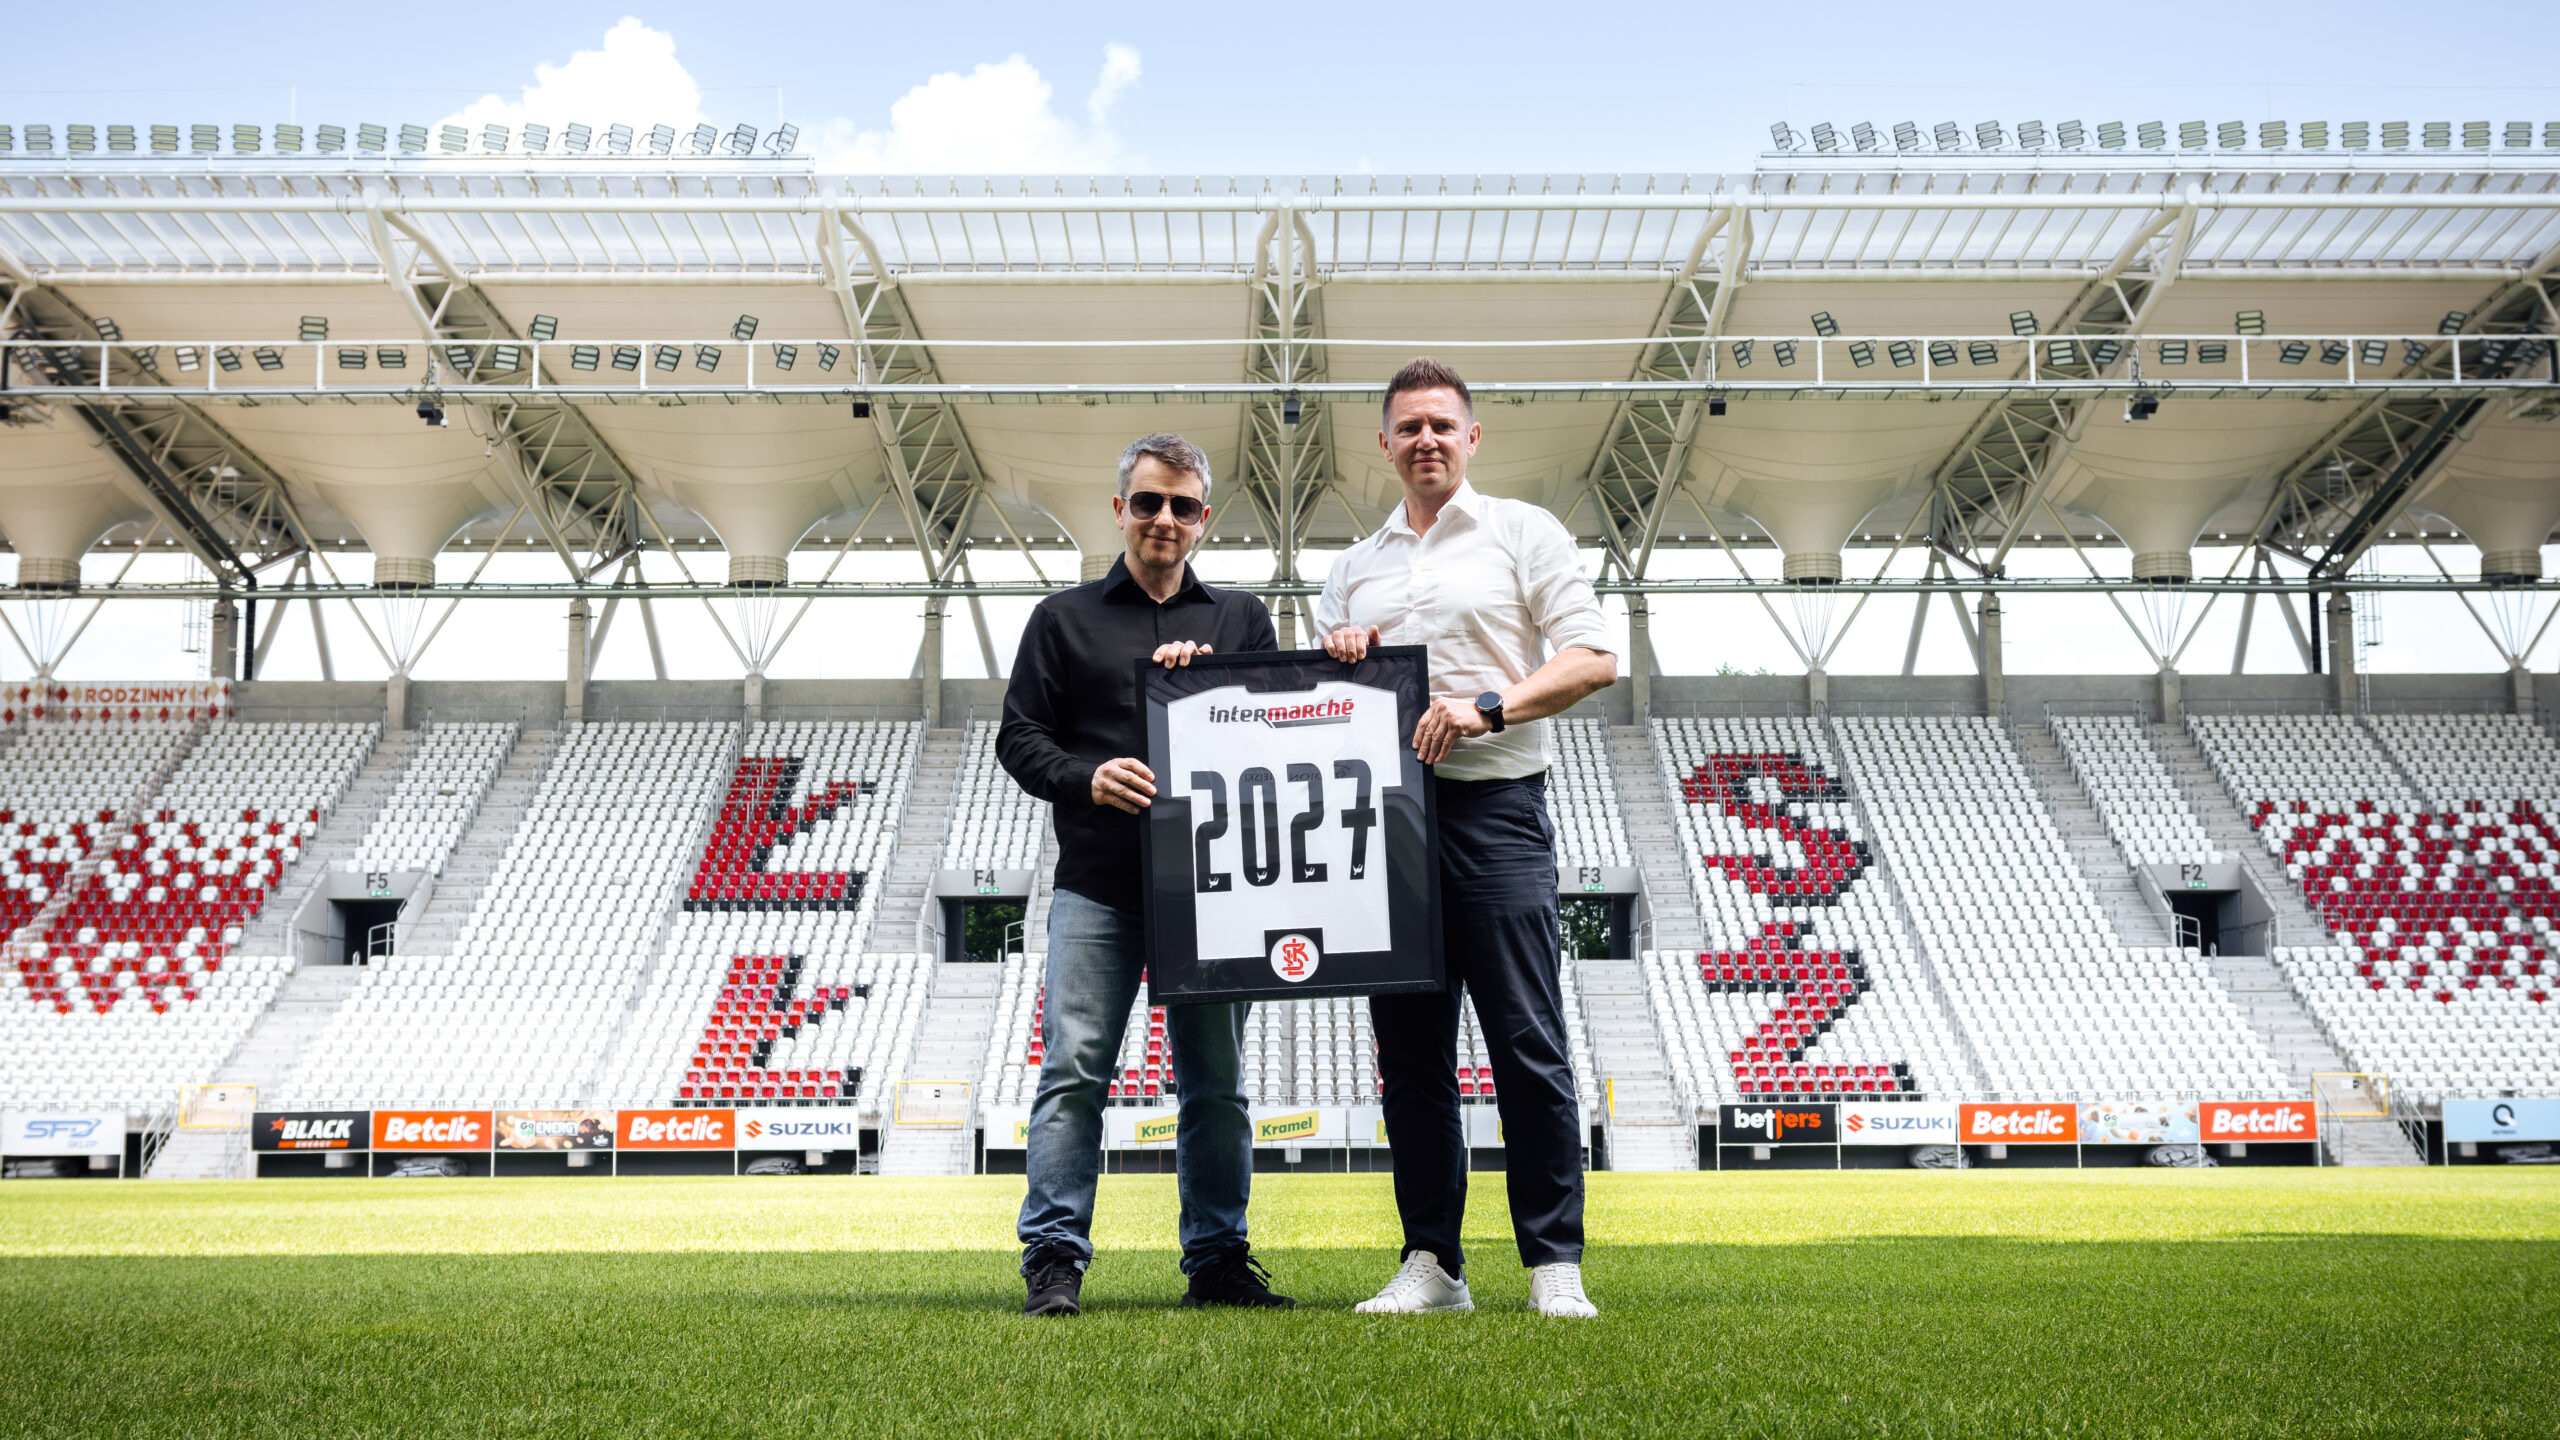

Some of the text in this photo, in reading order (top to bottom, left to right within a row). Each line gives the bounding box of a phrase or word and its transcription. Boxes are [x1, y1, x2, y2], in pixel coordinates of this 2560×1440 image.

[84, 687, 188, 703] RODZINNY
[1190, 758, 1377, 894] 2027
[366, 872, 389, 889] F5
[974, 869, 996, 887] F4
[1579, 867, 1601, 884] F3
[2181, 864, 2204, 881] F2
[23, 1119, 102, 1138] SFD
[281, 1119, 354, 1139] BLACK
[384, 1115, 481, 1142] Betclic
[536, 1121, 578, 1135] ENERGY
[629, 1114, 724, 1141] Betclic
[768, 1122, 852, 1136] SUZUKI
[1261, 1116, 1313, 1137] Kramel
[1734, 1108, 1822, 1140] betters
[1870, 1117, 1952, 1130] SUZUKI
[1971, 1109, 2066, 1135] Betclic
[2211, 1106, 2305, 1134] Betclic
[1141, 1123, 1178, 1138] Kram
